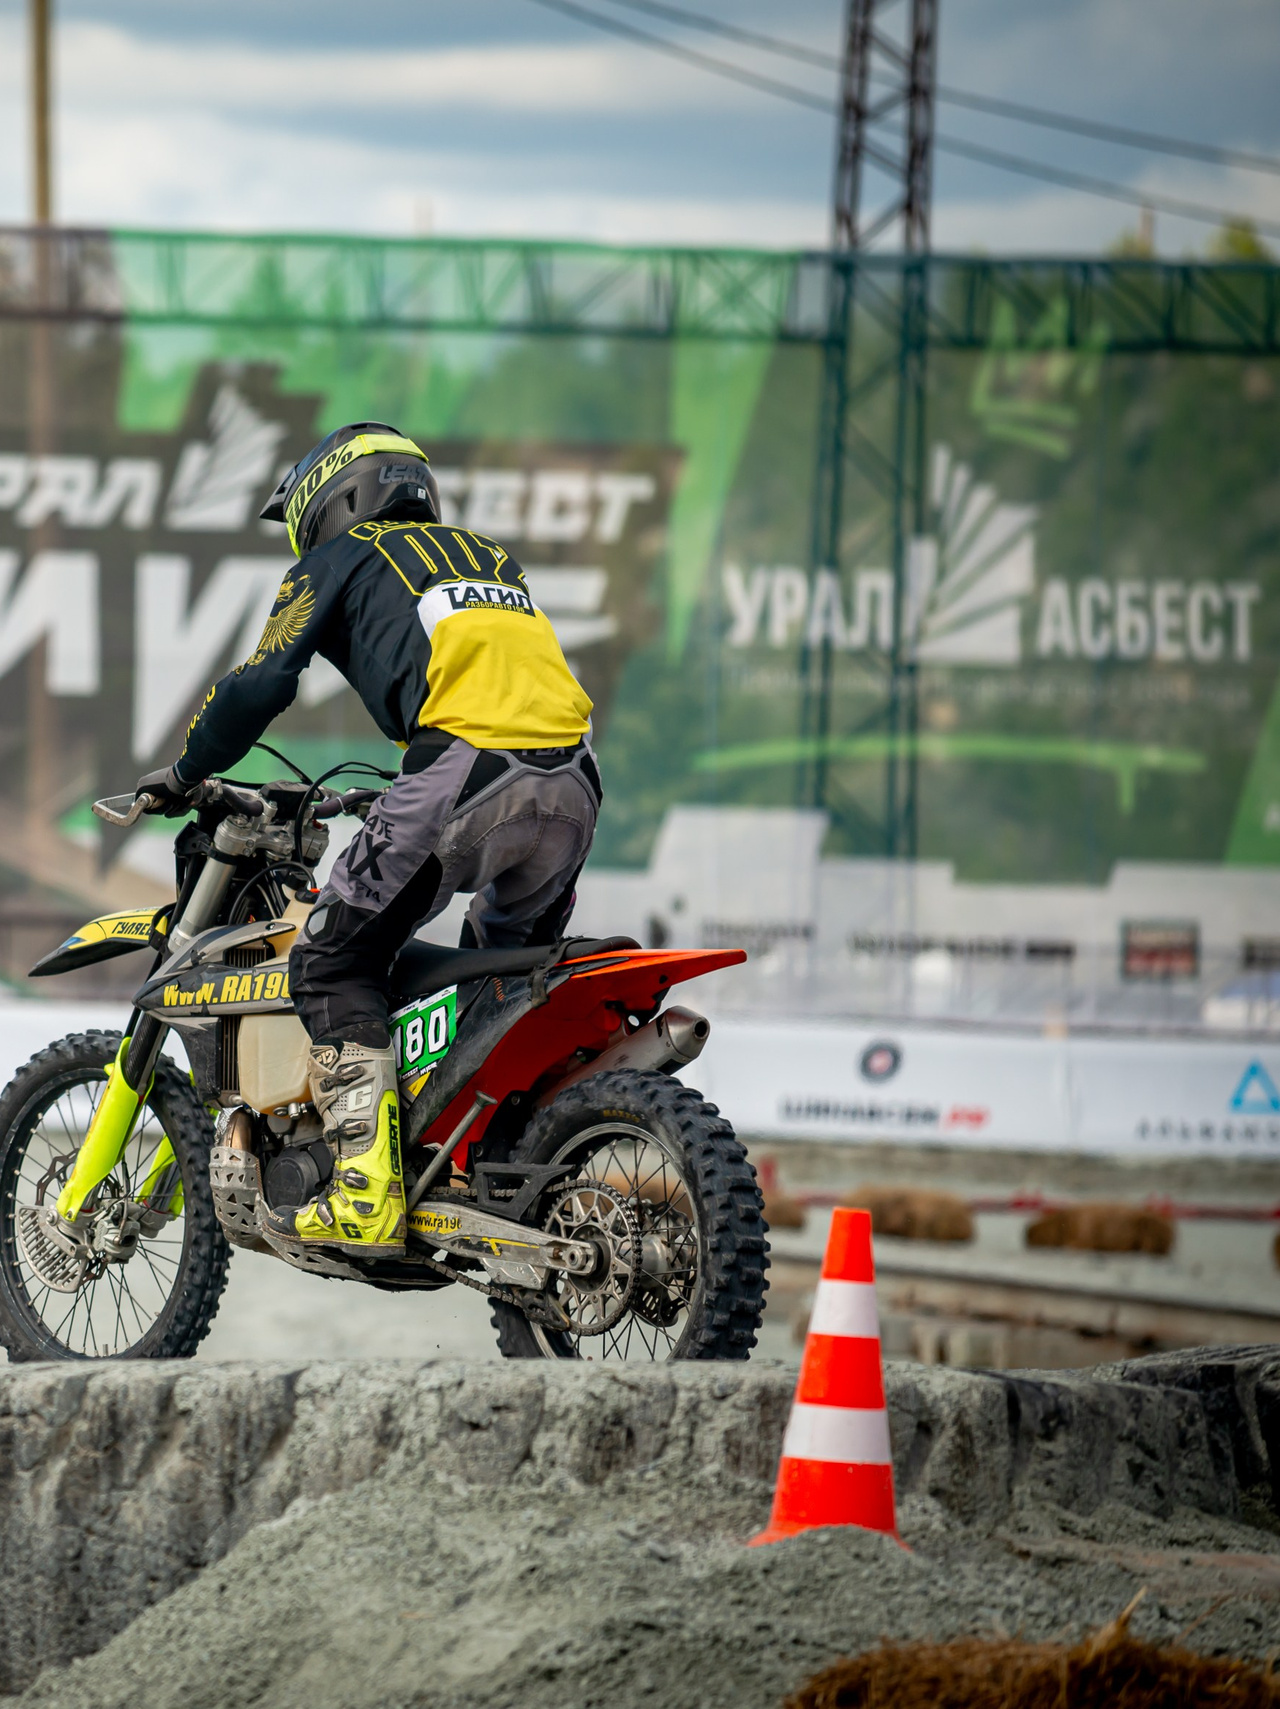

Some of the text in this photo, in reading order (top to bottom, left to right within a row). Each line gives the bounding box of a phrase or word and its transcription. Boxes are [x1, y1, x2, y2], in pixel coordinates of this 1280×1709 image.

[441, 586, 536, 618] ТАГИЛ
[720, 563, 1262, 664] УРАЛ АСБЕСТ
